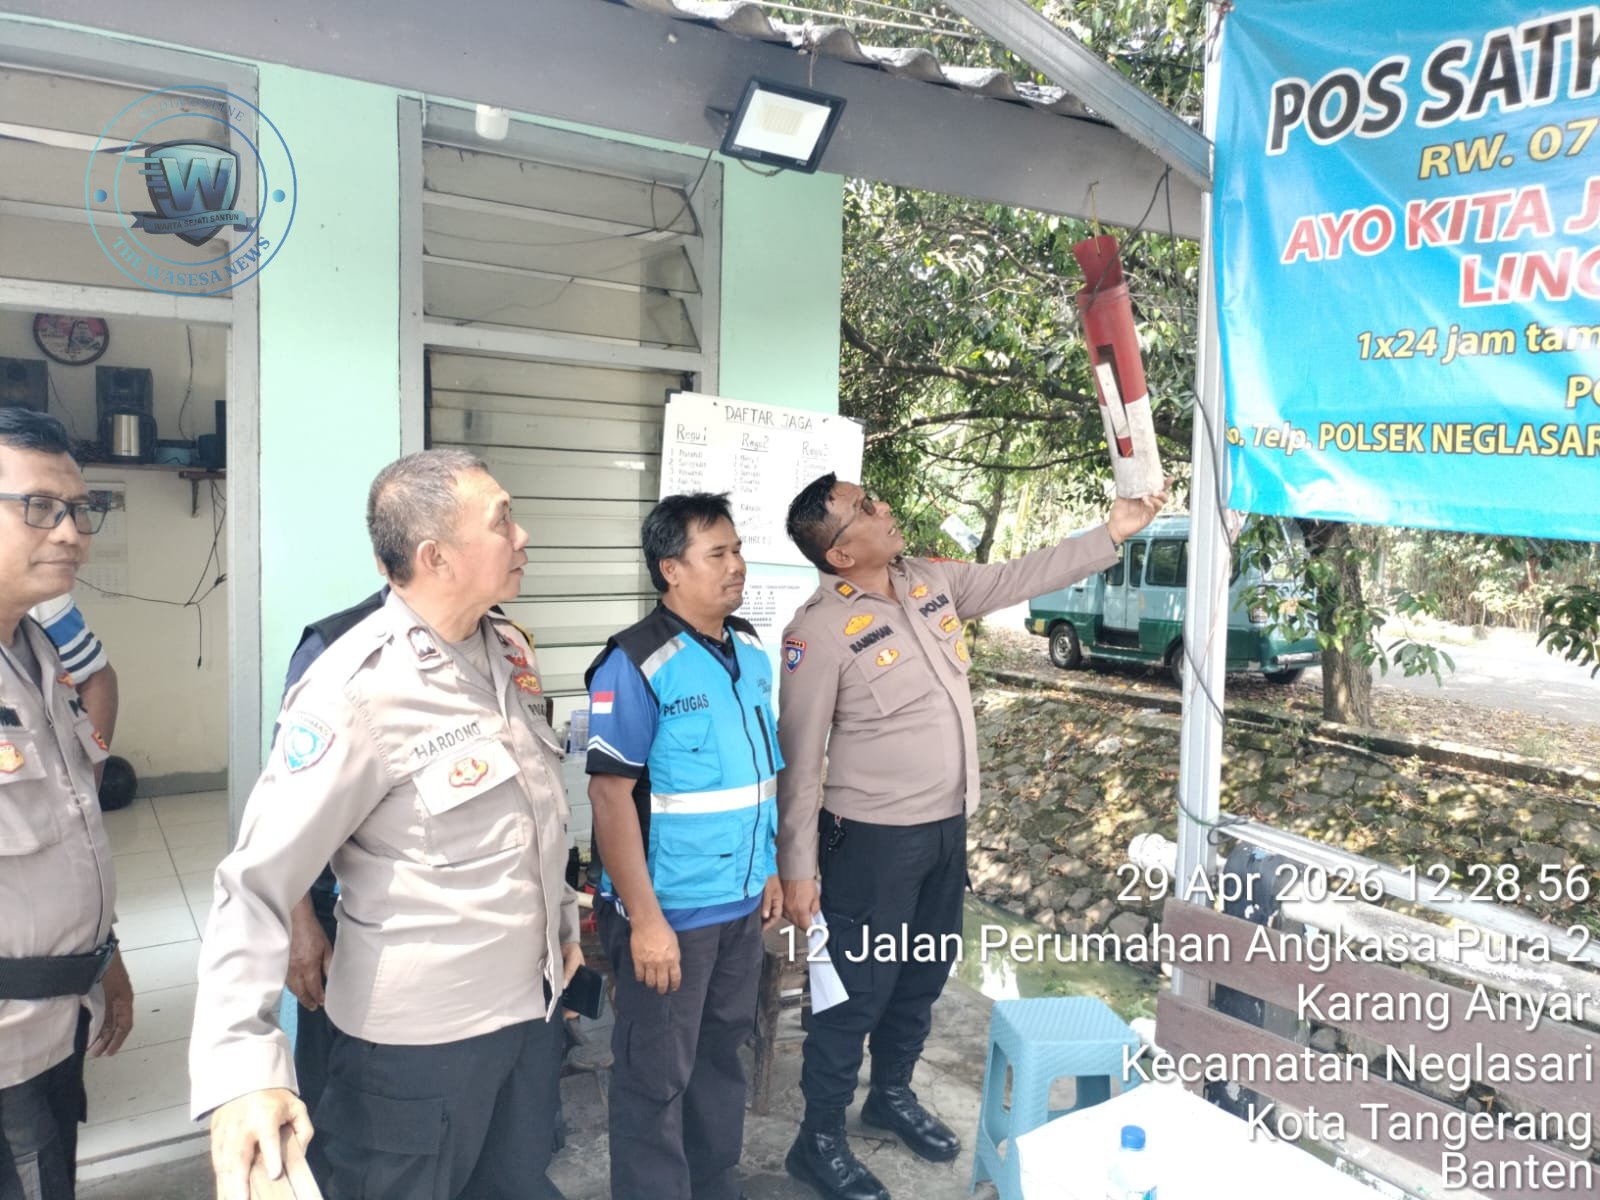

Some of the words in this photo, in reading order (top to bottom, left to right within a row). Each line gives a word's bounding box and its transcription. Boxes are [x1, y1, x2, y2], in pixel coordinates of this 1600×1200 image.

[1268, 58, 1408, 153] POS
[1418, 133, 1513, 180] RW.
[1528, 118, 1599, 161] 07
[1281, 206, 1393, 263] AYO
[1405, 186, 1553, 249] KITA
[1358, 329, 1438, 360] 1x24
[1439, 324, 1516, 365] jam
[725, 405, 775, 426] DAFTAR
[781, 413, 814, 432] JAGA
[1252, 421, 1313, 456] Telp.
[1319, 422, 1426, 453] POLSEK
[663, 693, 710, 717] PETUGAS
[413, 721, 481, 760] HARDONO
